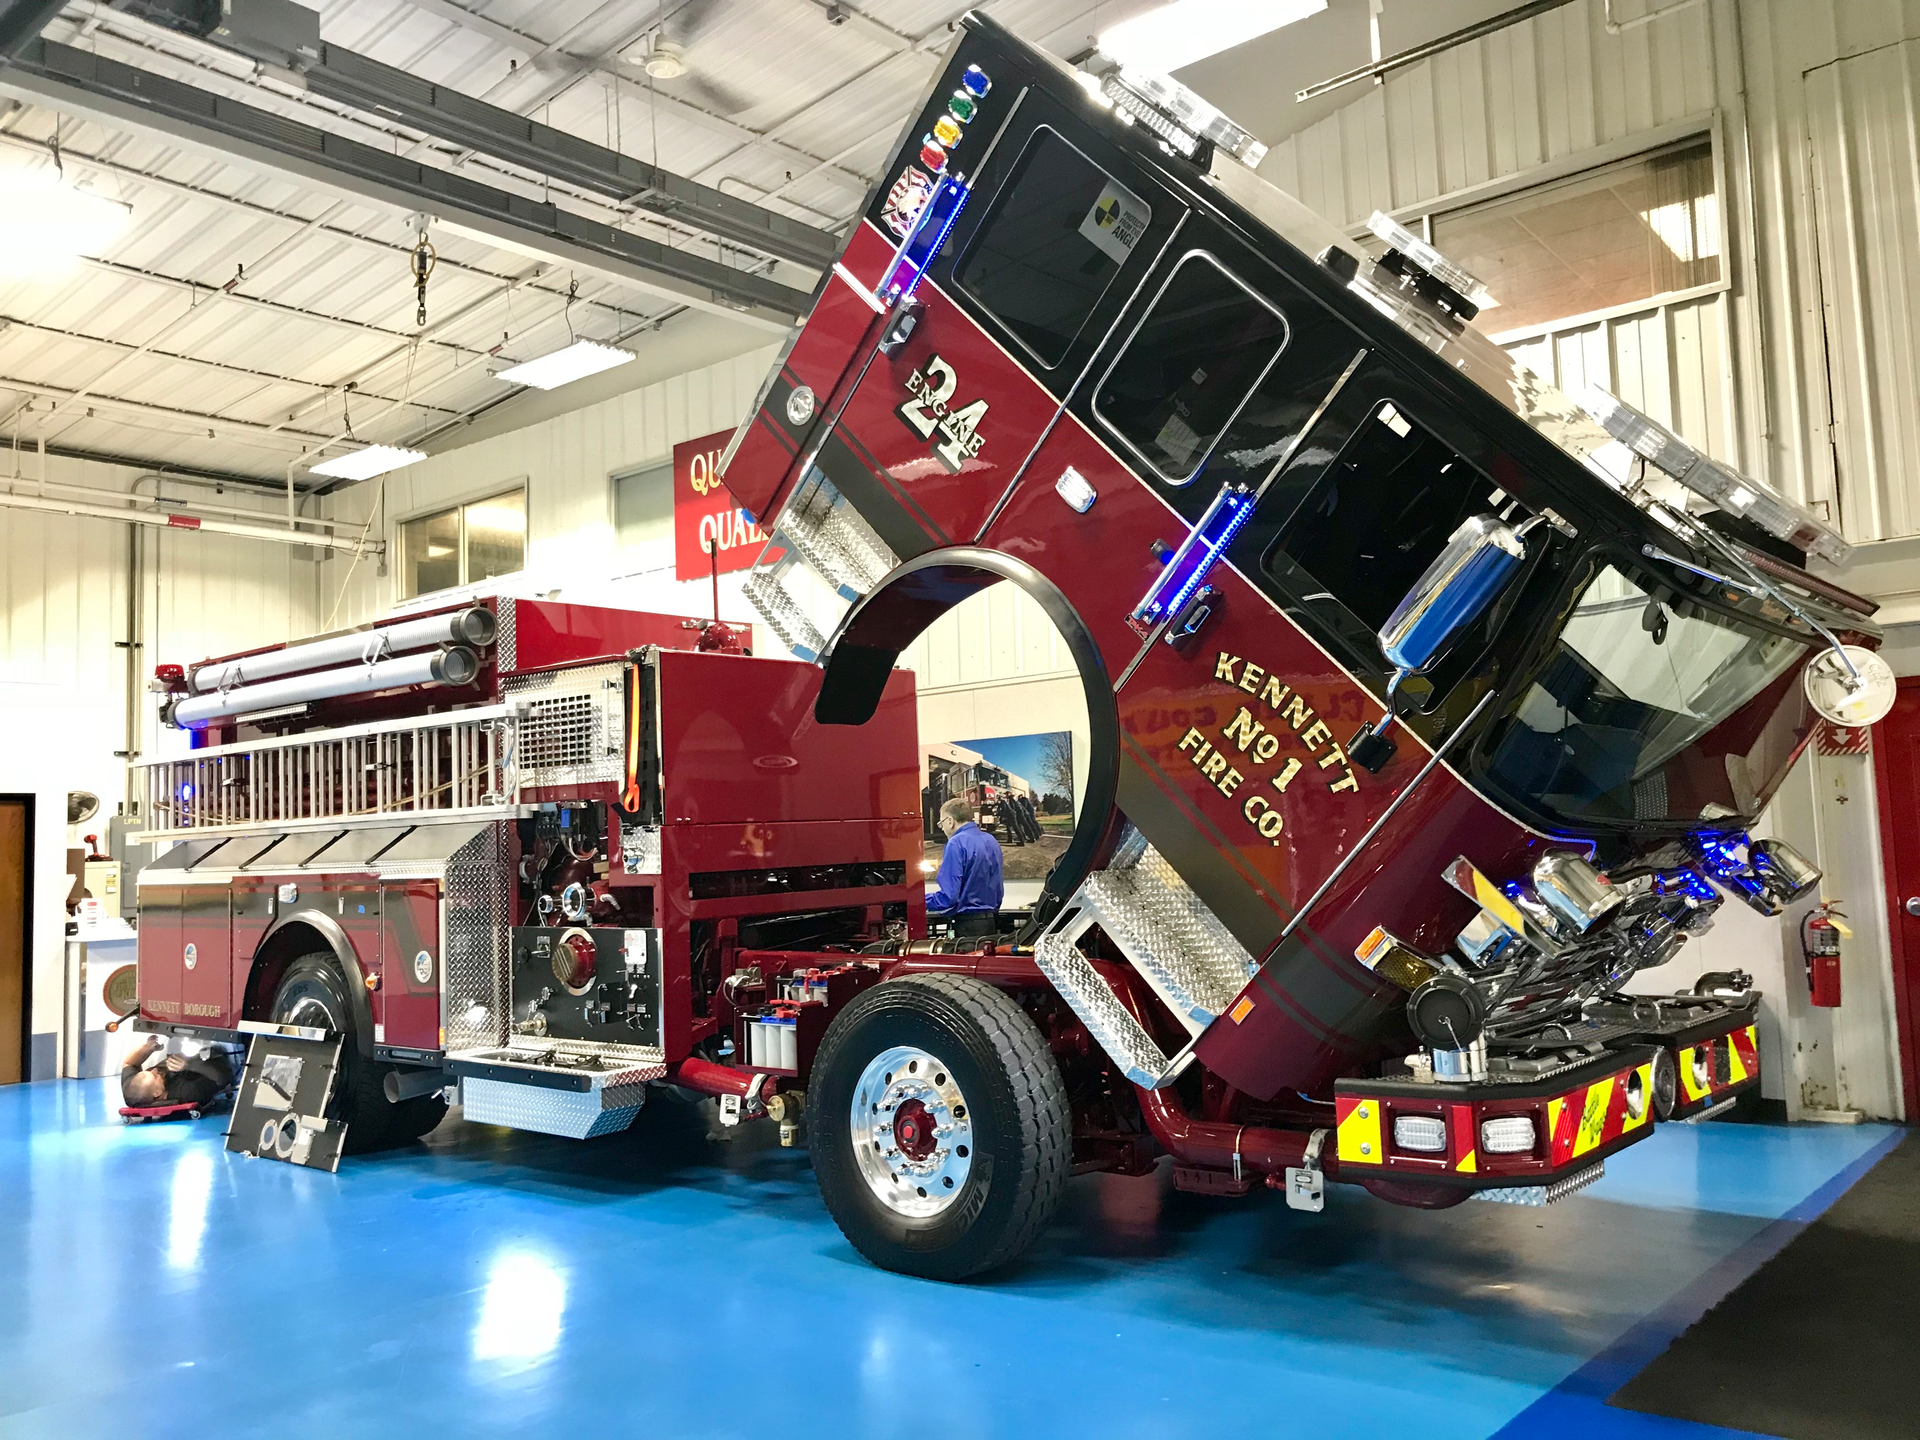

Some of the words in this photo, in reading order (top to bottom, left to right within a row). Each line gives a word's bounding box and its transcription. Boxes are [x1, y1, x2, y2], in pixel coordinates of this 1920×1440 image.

[897, 353, 990, 472] 24
[904, 367, 986, 458] ENGINE
[690, 448, 724, 496] QU
[699, 507, 770, 554] QUAL
[1213, 651, 1360, 795] KENNETT
[1177, 726, 1245, 799] FIRE
[1243, 795, 1284, 847] CO.
[1271, 757, 1303, 794] 1
[147, 999, 180, 1014] KENNETT
[184, 1003, 221, 1018] BOROUGH
